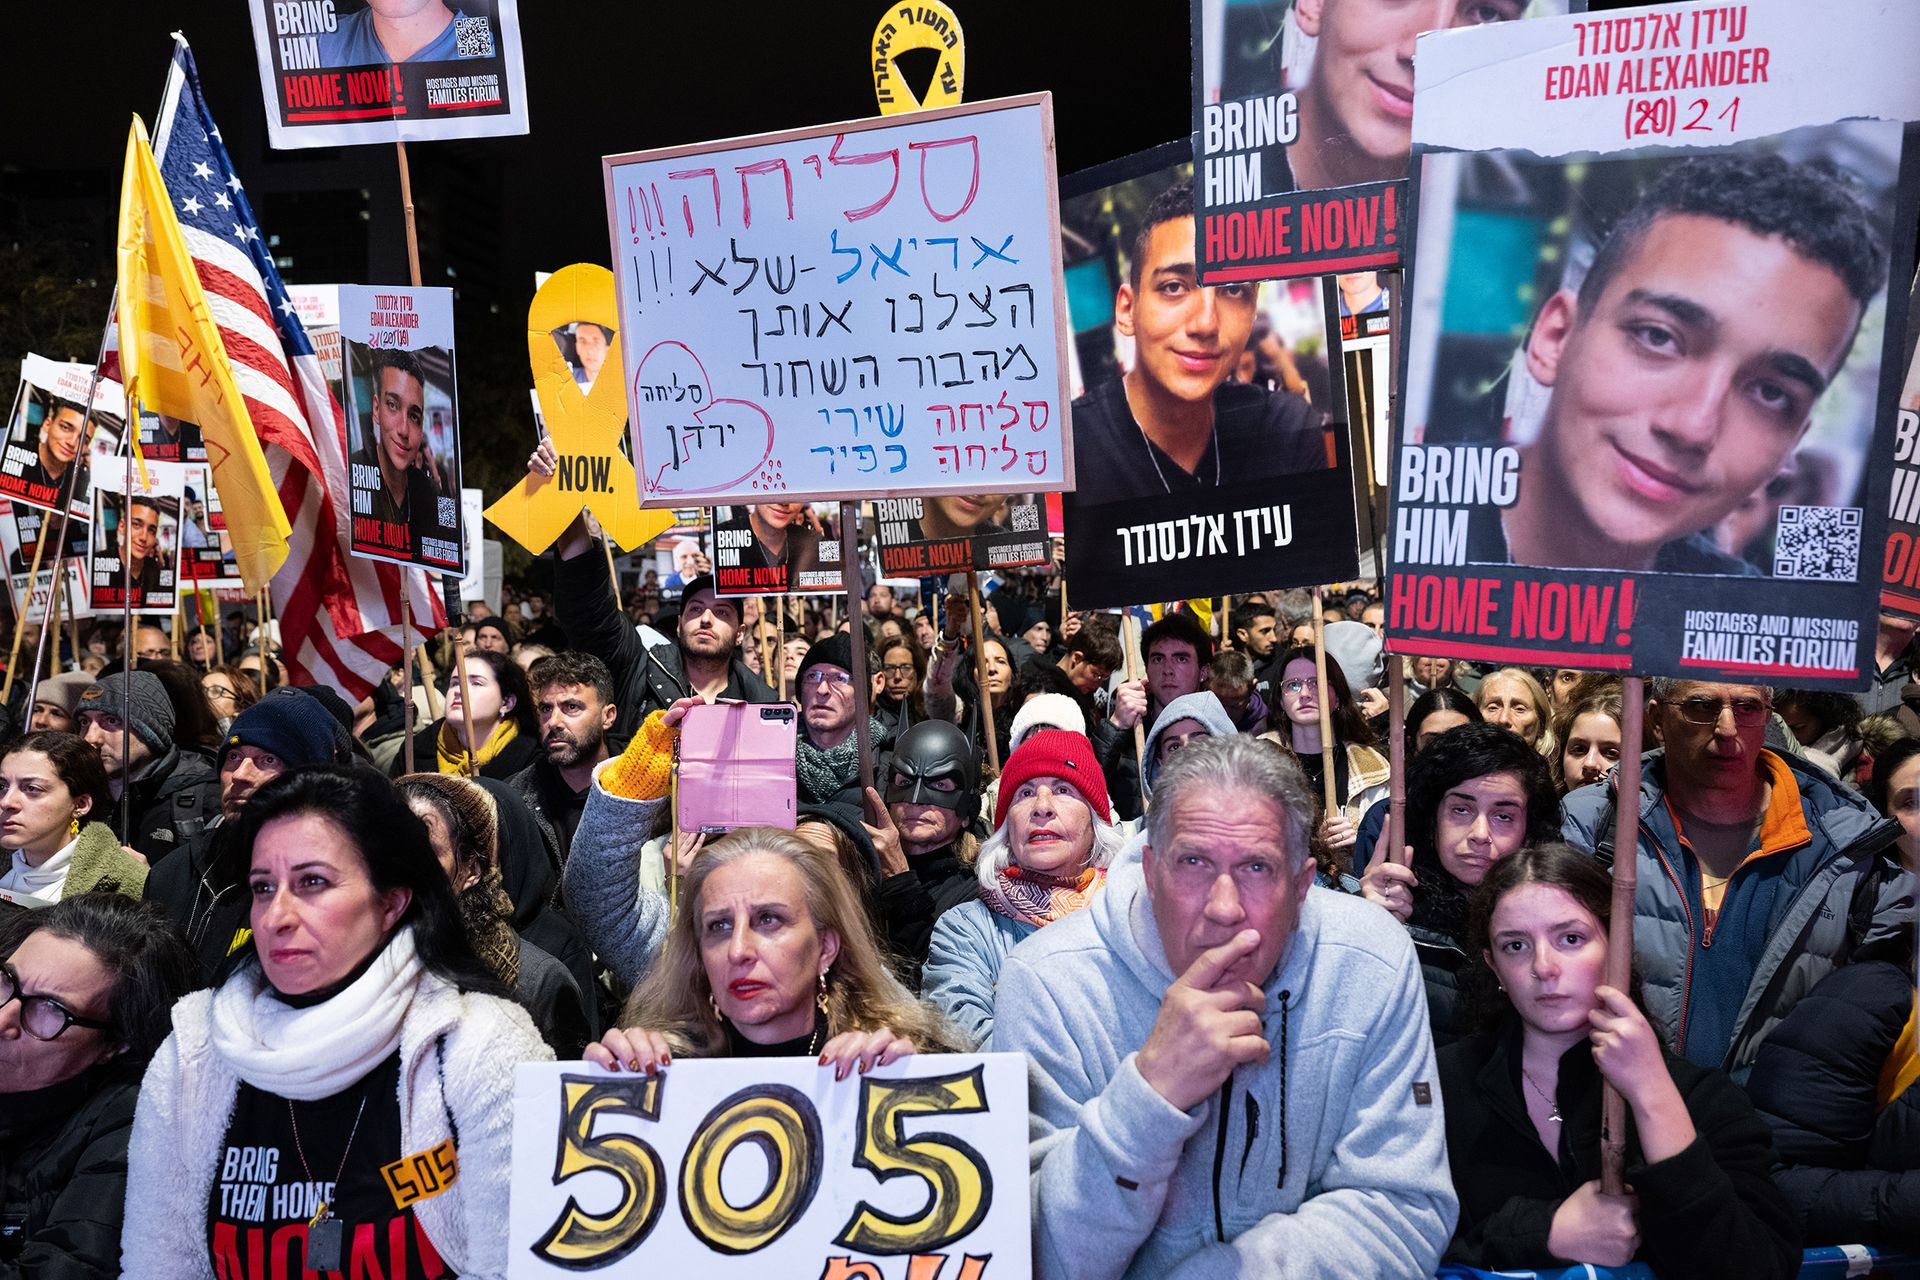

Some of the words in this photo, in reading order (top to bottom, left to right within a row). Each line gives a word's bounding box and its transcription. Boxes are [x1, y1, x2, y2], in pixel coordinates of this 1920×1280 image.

[274, 0, 337, 34] BRING
[1573, 12, 1682, 57] אלכסנדר
[1691, 6, 1747, 50] עידן
[279, 36, 321, 70] HIM
[875, 23, 897, 103] האחרון
[284, 73, 344, 108] HOME
[350, 64, 404, 105] NOW!
[426, 77, 457, 89] HOSTAGES
[458, 76, 471, 88] AND
[471, 75, 498, 87] MISSING
[940, 61, 957, 95] עד
[1545, 61, 1610, 101] EDAN
[1616, 47, 1770, 94] ALEXANDER
[427, 87, 467, 105] FAMILIES
[468, 86, 500, 102] FORUM
[1203, 93, 1298, 155] BRING
[1682, 96, 1740, 132] 21
[1204, 152, 1262, 207] HIM
[1205, 206, 1291, 263] HOME
[1301, 186, 1396, 254] NOW!
[831, 228, 1020, 284] אריאל
[370, 311, 384, 327] EDAN
[385, 312, 419, 329] ALEXANDER
[885, 272, 1034, 334] הצלנו
[738, 300, 853, 361] אותך
[741, 355, 880, 398] השחור
[897, 343, 1038, 389] מהבור
[641, 371, 703, 403] סליחה
[817, 402, 904, 438] שירי
[926, 390, 1049, 436] סליחה
[5, 444, 38, 467] BRING
[666, 423, 735, 472] ירדן
[809, 444, 908, 475] כפיר
[932, 434, 1047, 476] סליחה
[1, 458, 25, 477] HIM
[352, 463, 381, 491] BRING
[558, 455, 615, 494] NOW.
[1398, 445, 1520, 506] BRING
[28, 482, 59, 503] NOW!
[353, 489, 372, 515] HIM
[877, 497, 924, 522] BRING
[354, 516, 382, 545] HOME
[384, 521, 411, 550] NOW!
[717, 529, 752, 549] BRING
[880, 521, 910, 546] HIM
[1116, 513, 1228, 566] אלכסנדר
[1232, 504, 1293, 557] עידן
[1394, 507, 1469, 566] HIM
[93, 557, 120, 572] BRING
[718, 549, 741, 567] HIM
[883, 546, 926, 571] HOME
[928, 538, 972, 566] NOW!
[989, 551, 1019, 565] FAMILIES
[1020, 549, 1045, 562] FORUM
[93, 572, 111, 587] HIM
[719, 568, 751, 587] HOME
[753, 564, 788, 586] NOW!
[1389, 573, 1502, 636] HOME
[1510, 578, 1635, 647] NOW!
[1684, 610, 1757, 635] HOSTAGES
[1758, 615, 1790, 637] AND
[1791, 617, 1859, 642] MISSING
[1682, 630, 1776, 666] FAMILIES
[1778, 637, 1857, 671] FORUM
[386, 1143, 458, 1203] SOS
[530, 1063, 994, 1273] 505
